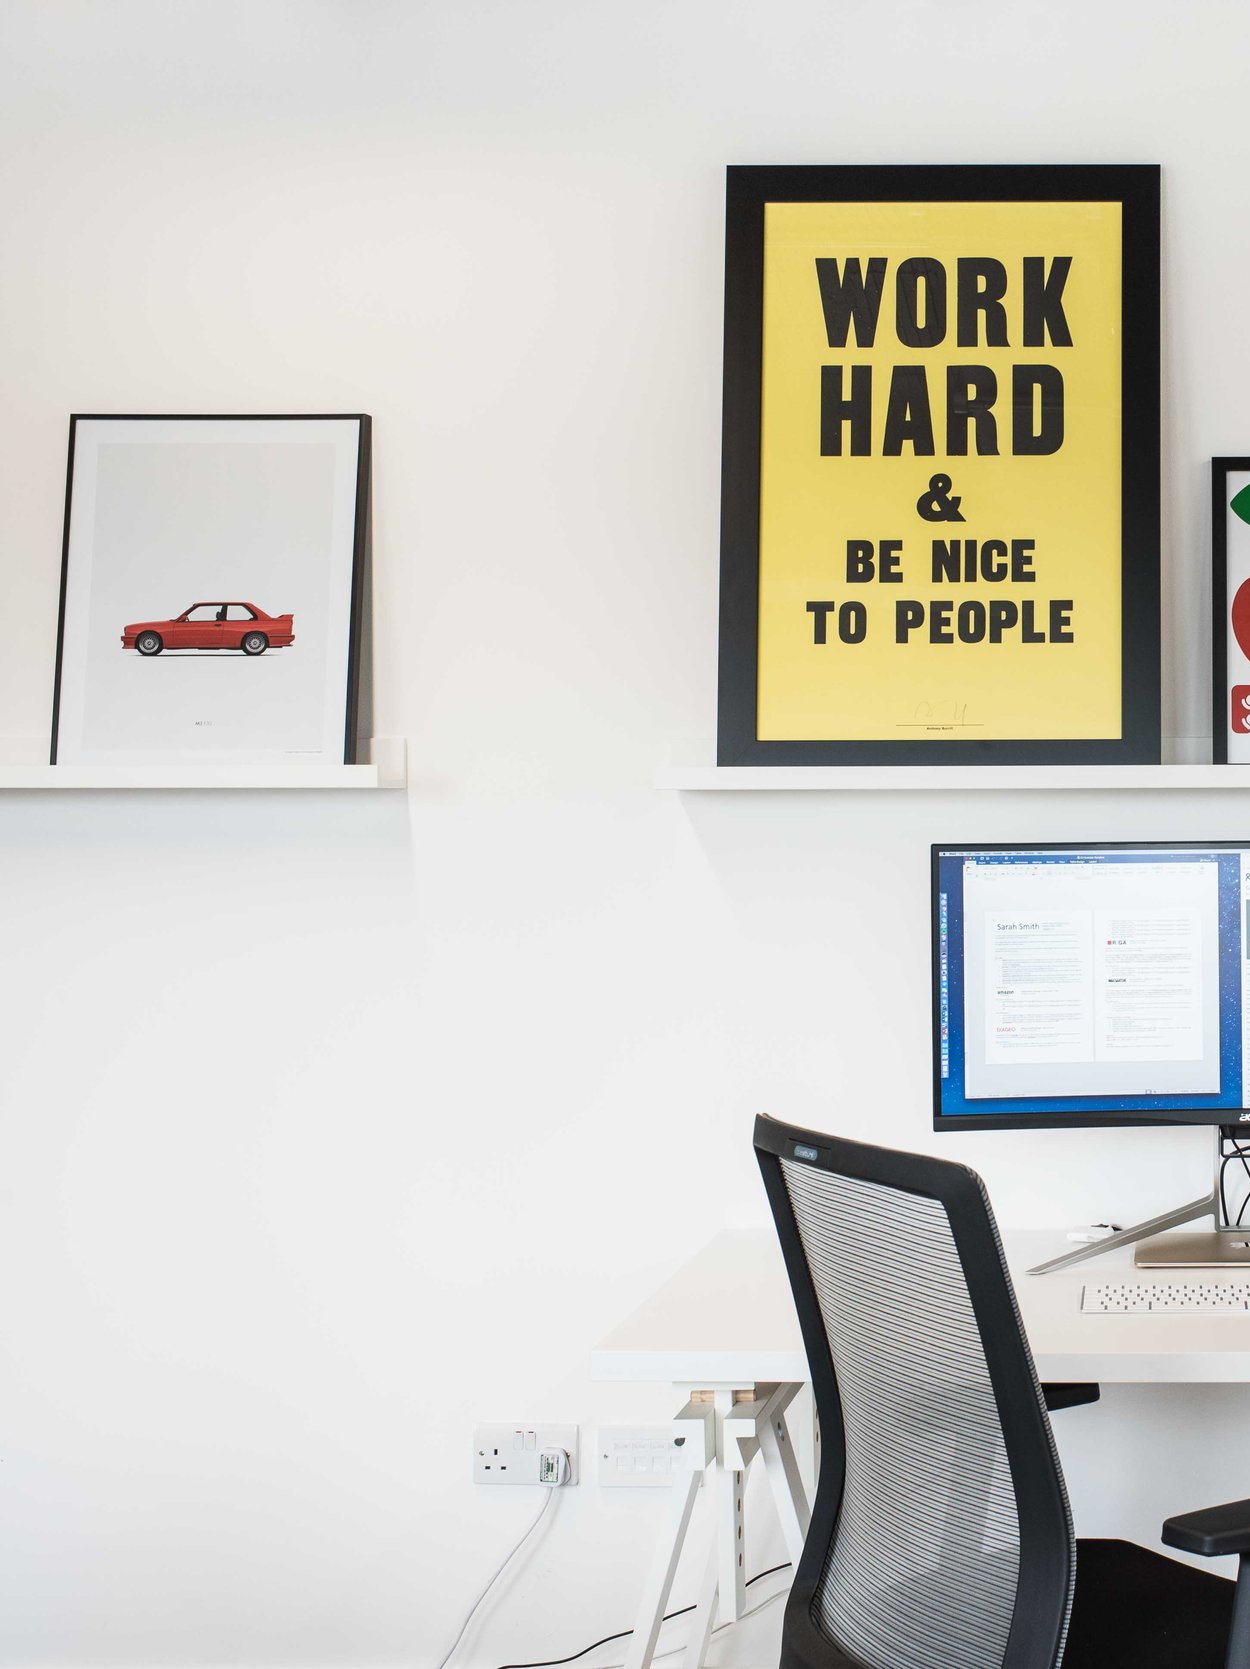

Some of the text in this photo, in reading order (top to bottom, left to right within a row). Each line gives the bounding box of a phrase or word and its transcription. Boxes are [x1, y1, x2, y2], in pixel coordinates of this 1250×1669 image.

[815, 256, 1073, 348] WORK
[820, 364, 1065, 457] HARD
[916, 473, 966, 523] &
[846, 539, 1036, 583] BE NICE
[806, 600, 1075, 644] TO PEOPLE
[997, 923, 1018, 931] Sarah
[1019, 922, 1040, 930] Smith
